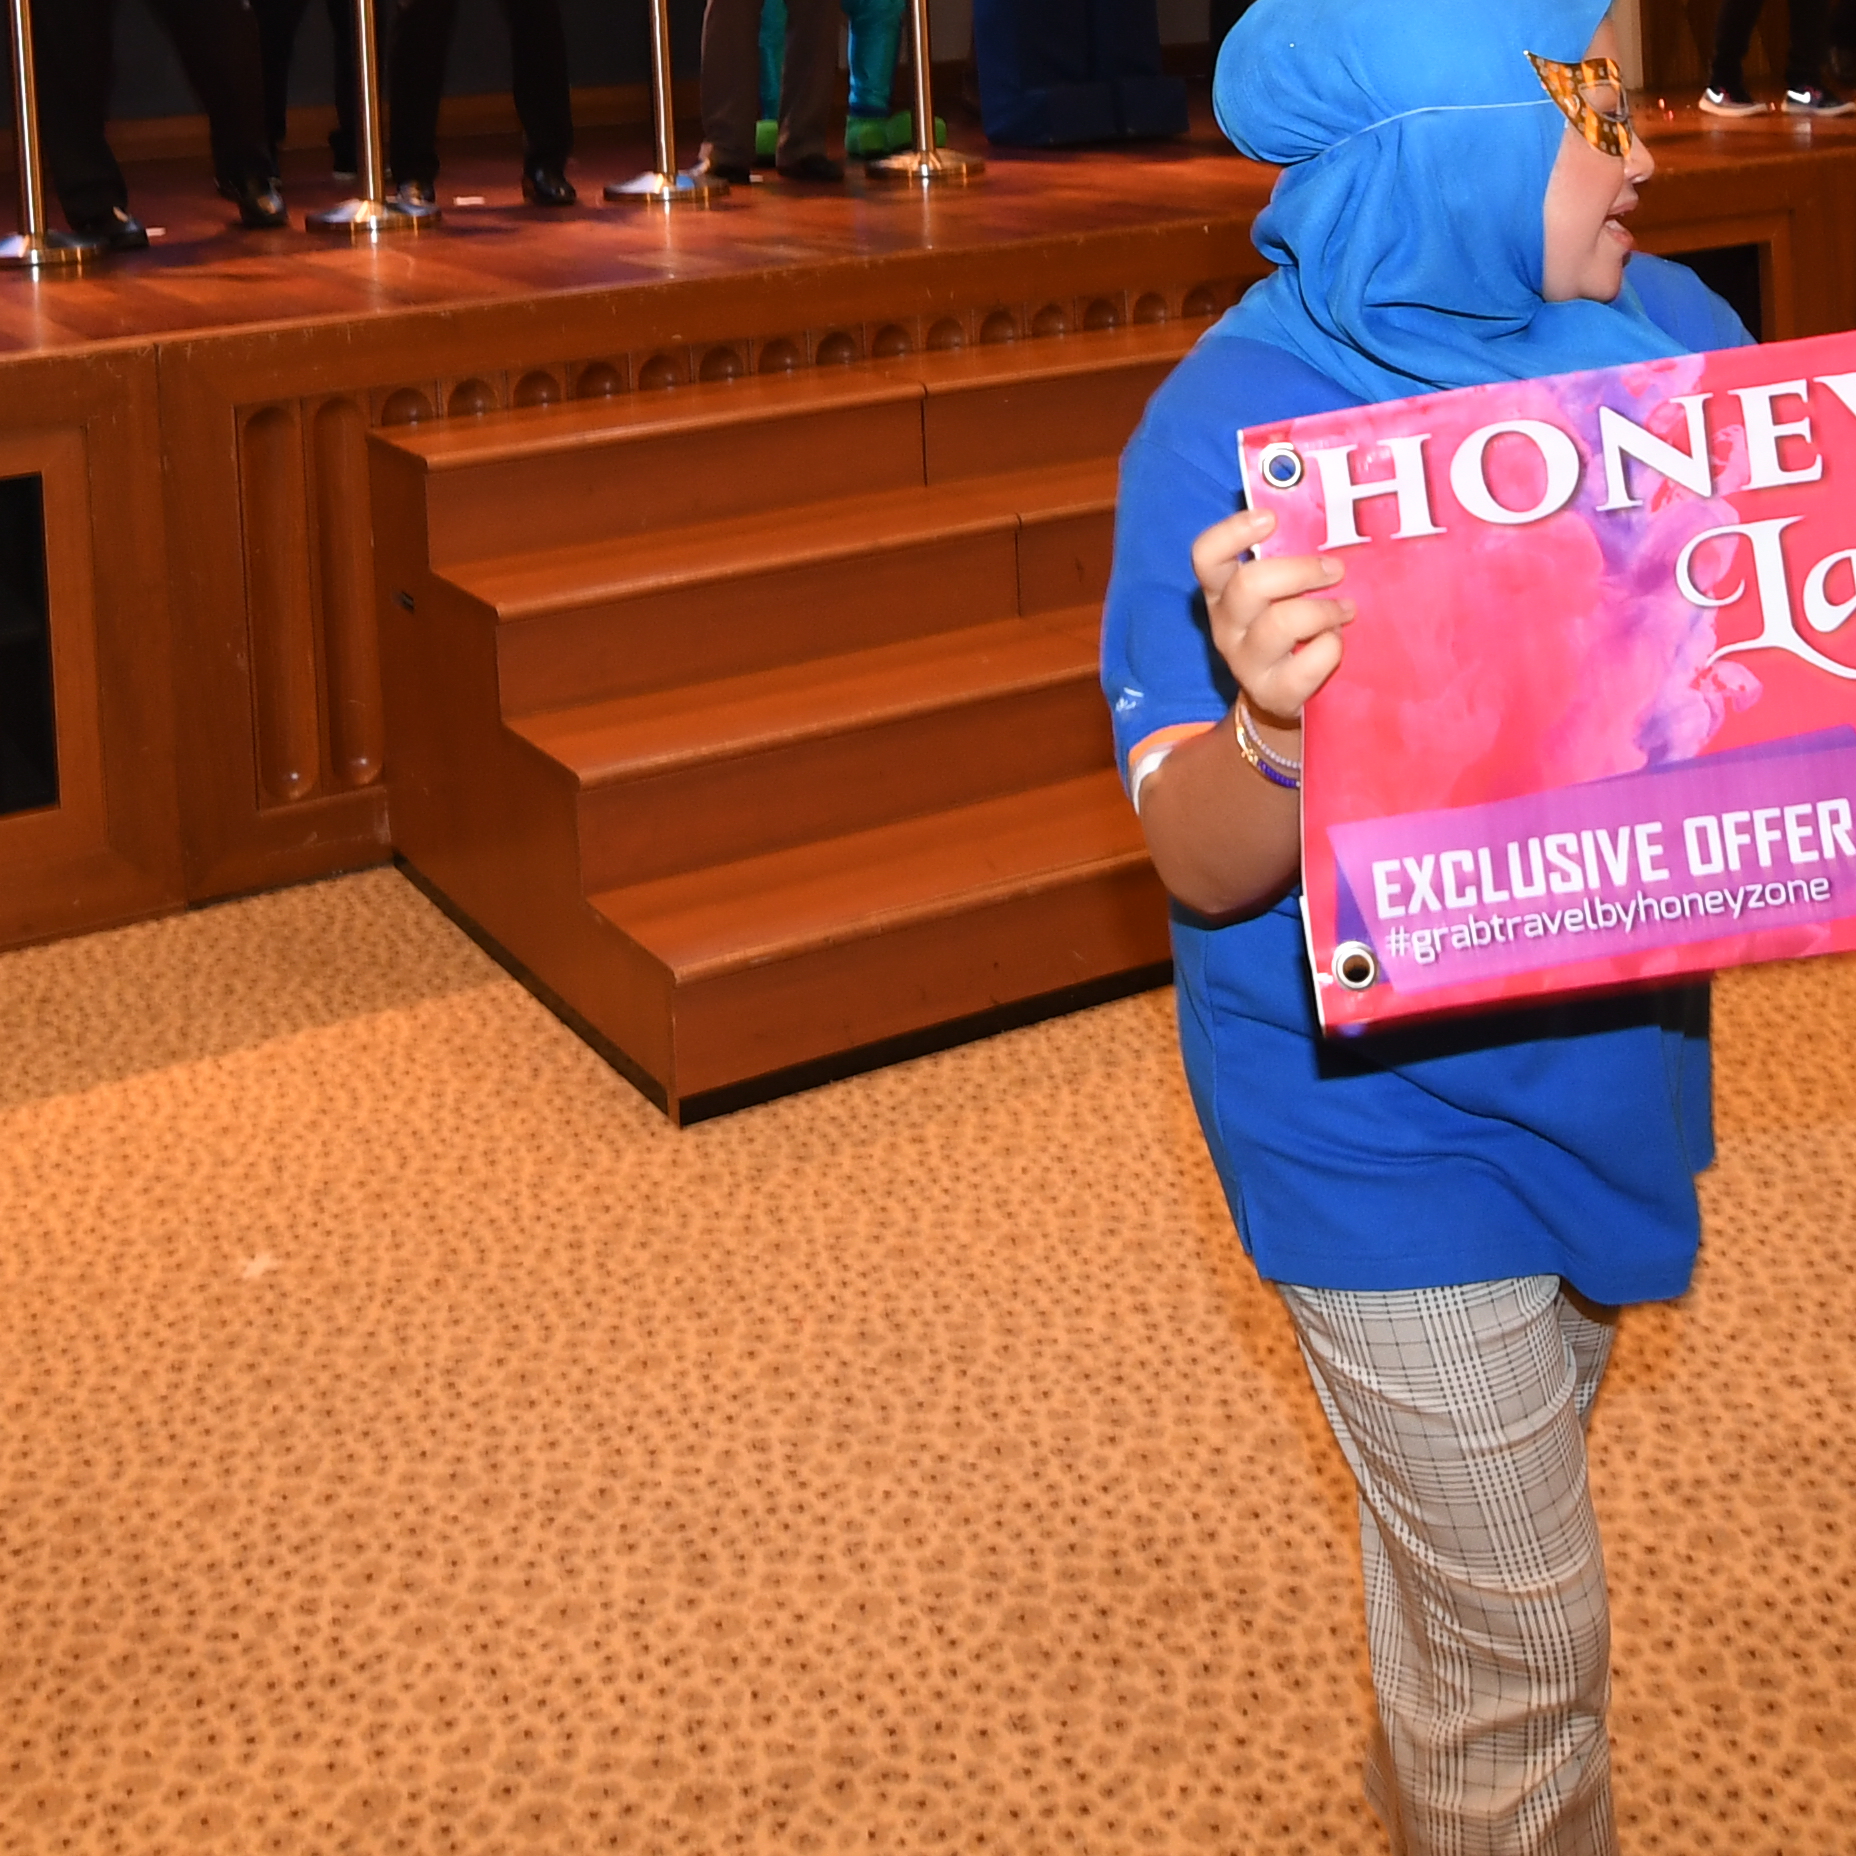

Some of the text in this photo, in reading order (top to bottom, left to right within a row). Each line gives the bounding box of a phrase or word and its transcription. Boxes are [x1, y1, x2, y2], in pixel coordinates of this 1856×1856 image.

[1372, 796, 1856, 920] EXCLUSIVE OFFER
[1384, 870, 1834, 966] #grabtravelbyhoneyzone
